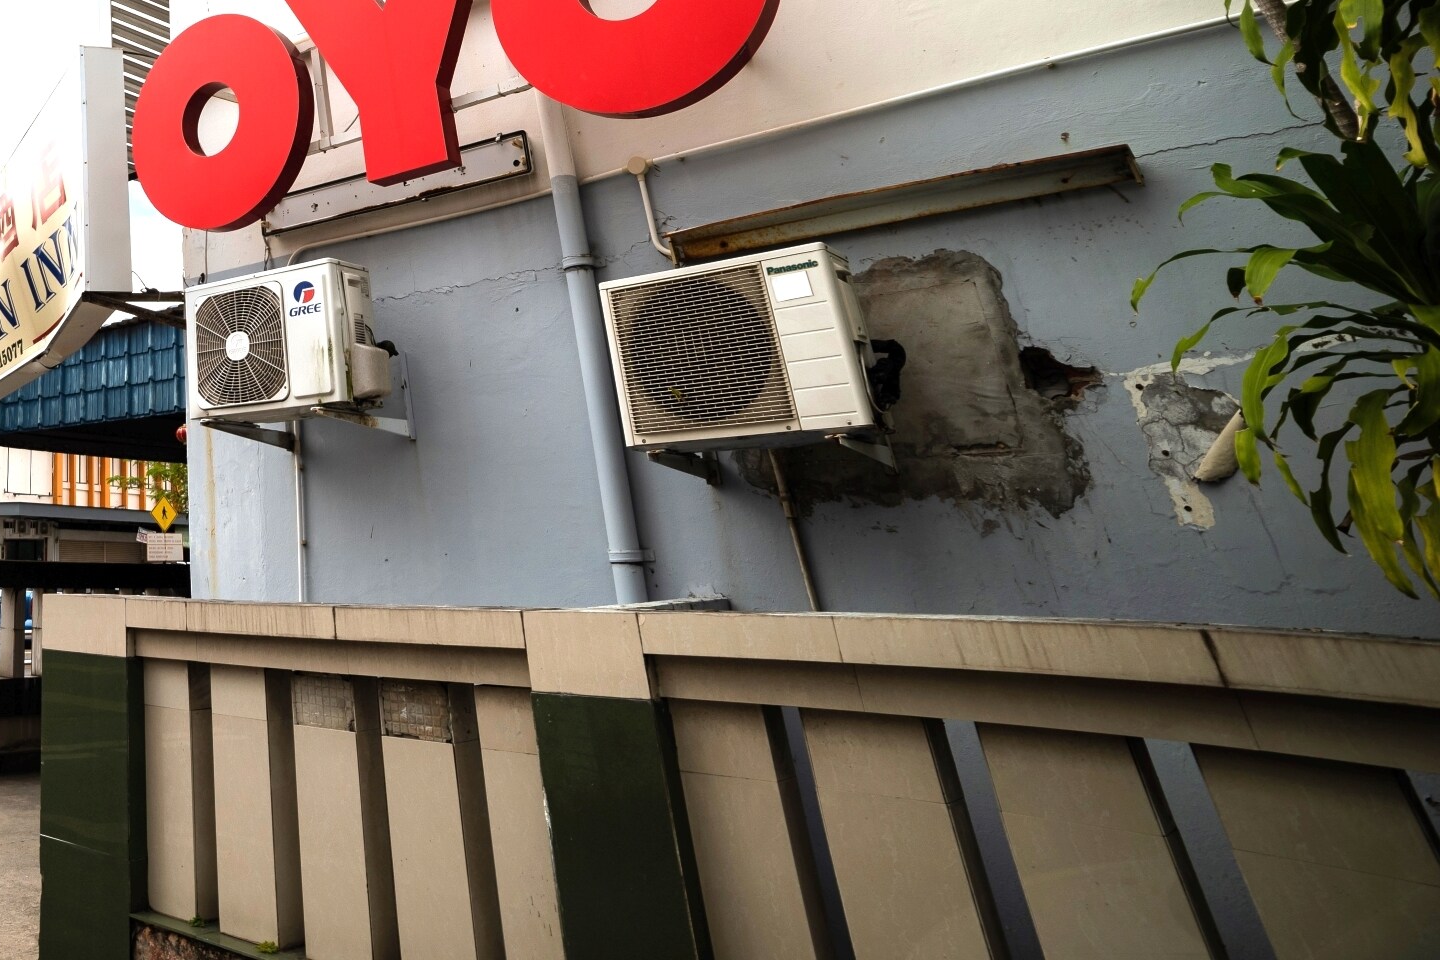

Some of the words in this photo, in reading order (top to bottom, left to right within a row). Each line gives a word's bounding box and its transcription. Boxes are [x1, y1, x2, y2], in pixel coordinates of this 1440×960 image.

[20, 201, 79, 313] INN
[766, 259, 818, 274] Panasonic
[289, 302, 322, 317] GREE
